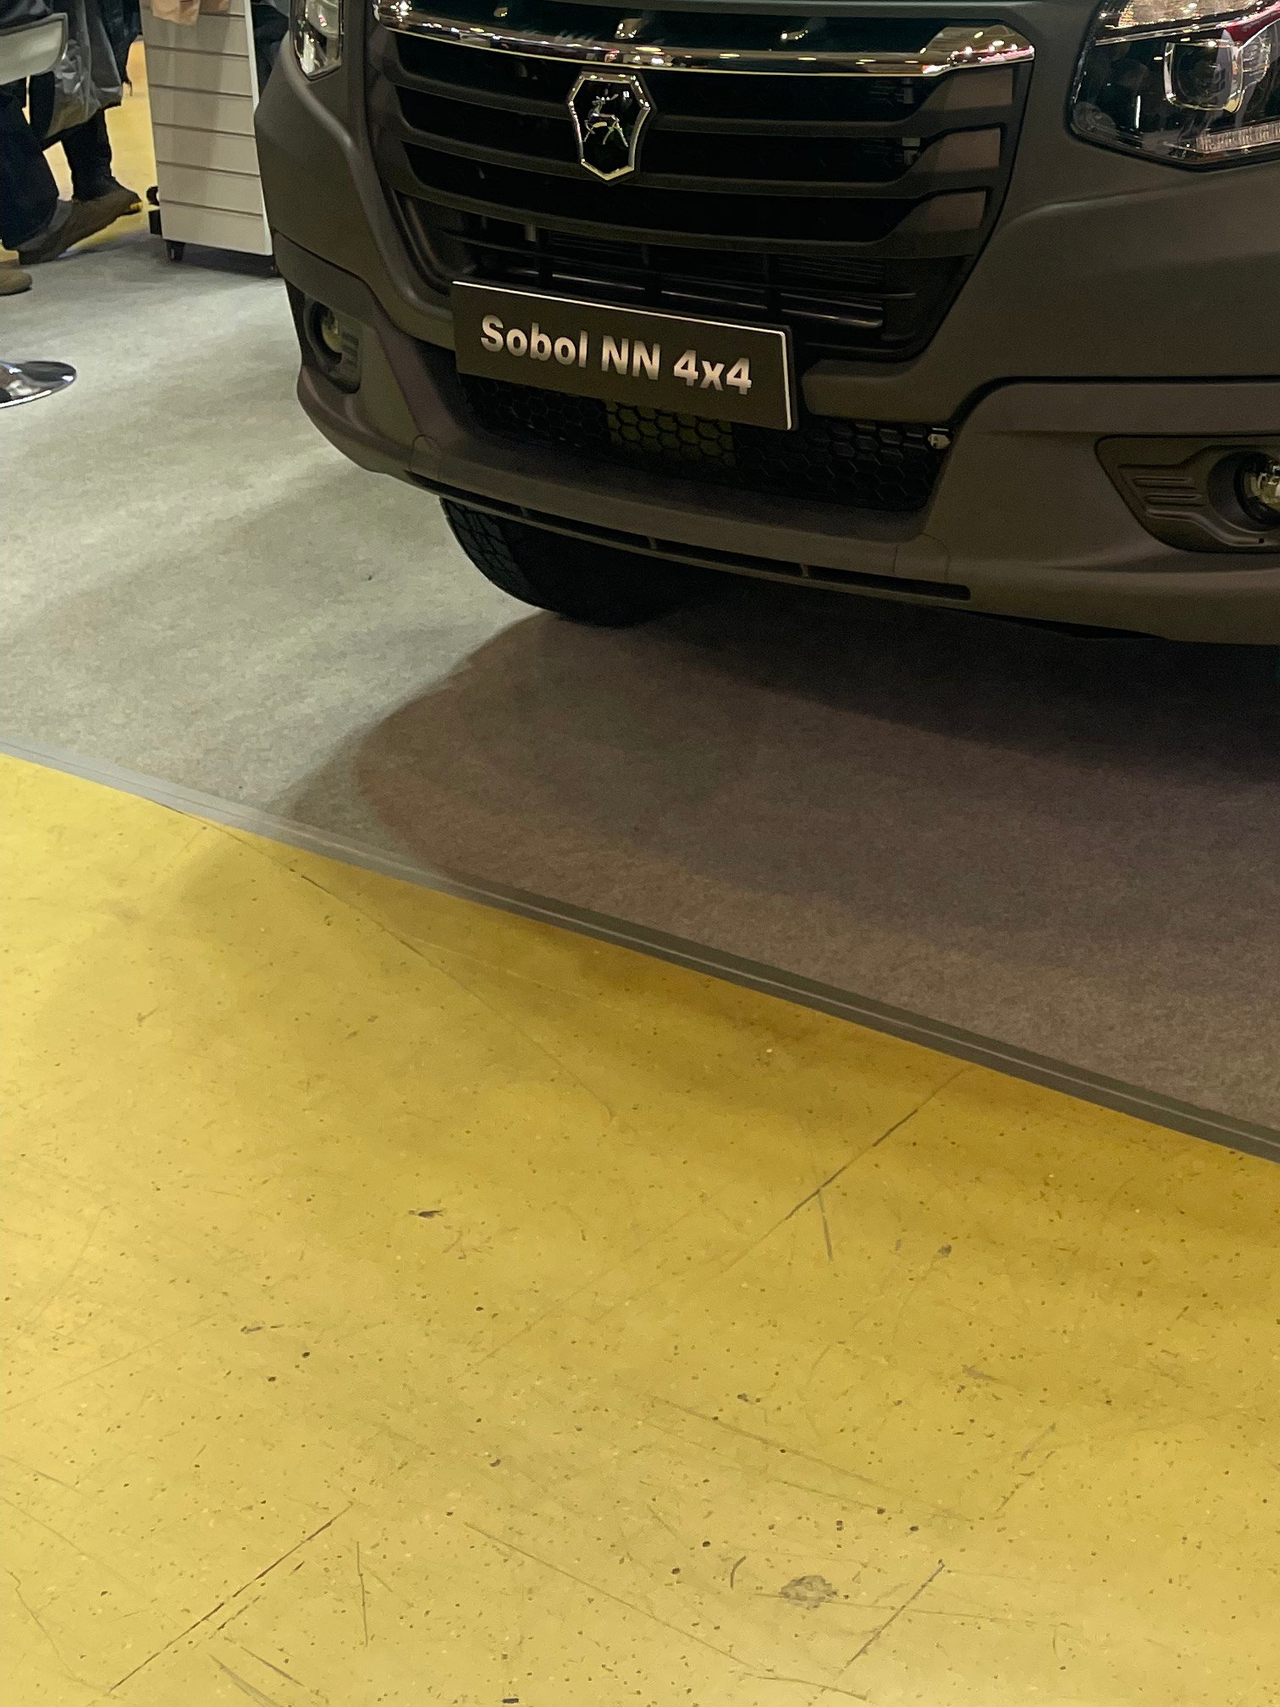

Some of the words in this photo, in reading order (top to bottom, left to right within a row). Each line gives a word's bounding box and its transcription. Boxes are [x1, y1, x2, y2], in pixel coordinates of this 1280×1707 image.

[481, 315, 588, 368] Sobol
[602, 335, 660, 381] NN
[674, 349, 752, 395] 4x4
